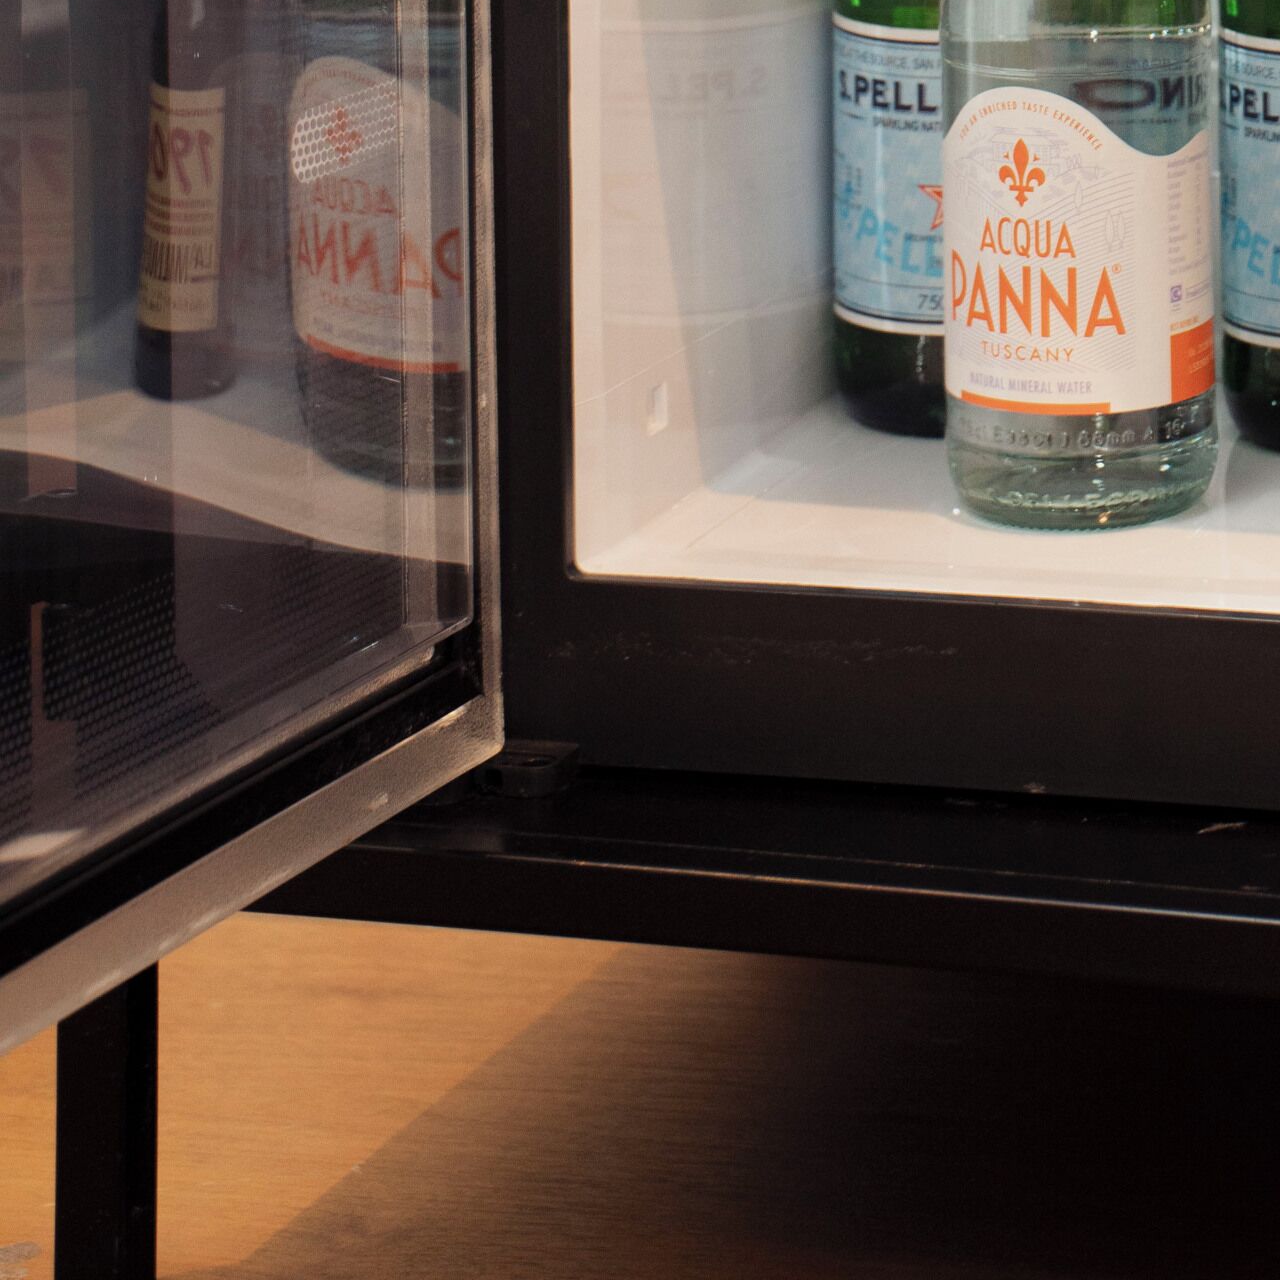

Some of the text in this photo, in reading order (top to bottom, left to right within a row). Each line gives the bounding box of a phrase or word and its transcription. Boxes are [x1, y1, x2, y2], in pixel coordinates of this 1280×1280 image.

[978, 100, 1018, 119] ENRICHED
[1022, 101, 1050, 116] TASTE
[1052, 109, 1104, 151] EXPERIENCE
[979, 216, 1076, 260] ACQUA
[952, 248, 1126, 338] PANNA
[980, 339, 1075, 363] TUSCANY
[1007, 378, 1053, 394] MINERAL
[1056, 380, 1093, 394] WATER
